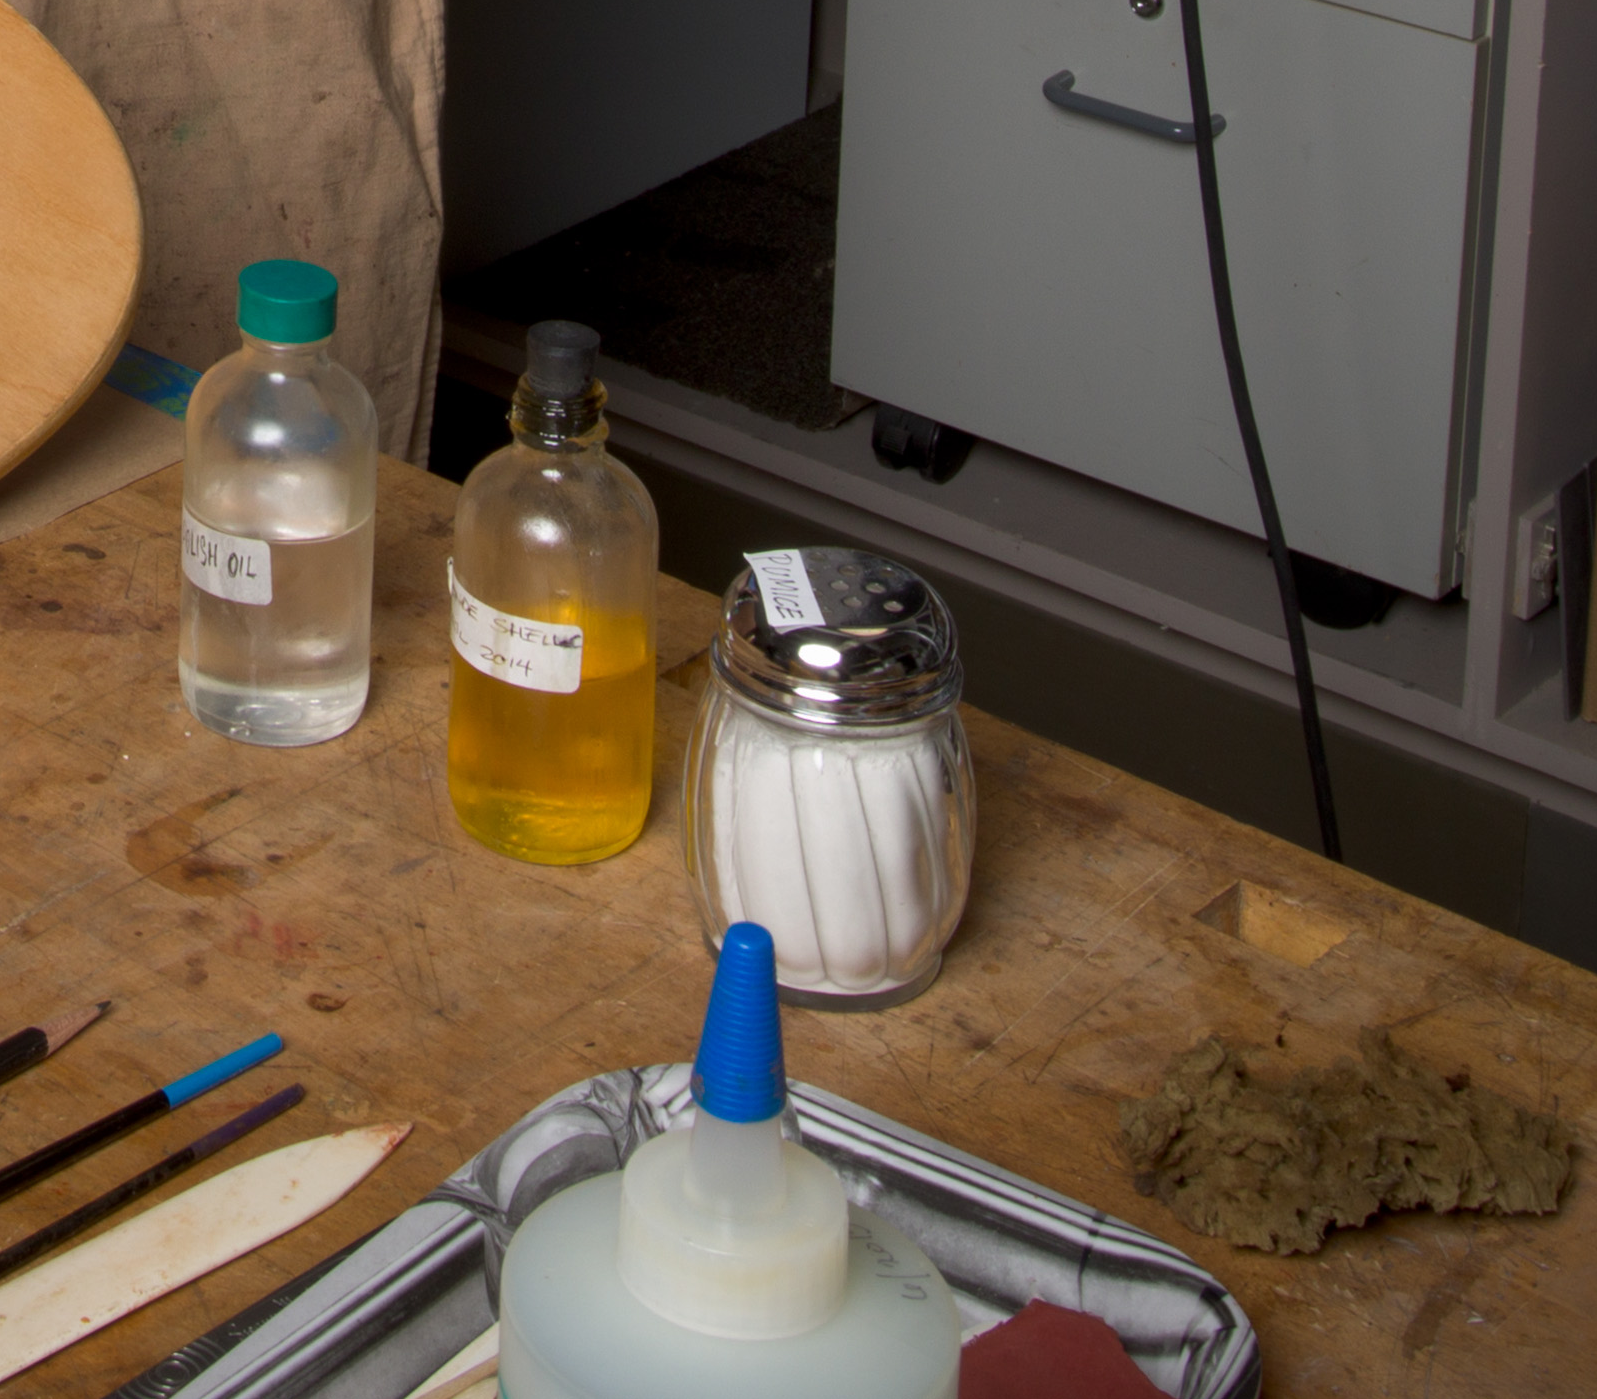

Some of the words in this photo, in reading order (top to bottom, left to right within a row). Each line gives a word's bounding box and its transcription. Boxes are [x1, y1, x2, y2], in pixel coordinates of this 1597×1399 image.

[185, 528, 218, 568] LISH
[227, 551, 257, 579] OIL
[751, 553, 805, 619] PUMICE
[479, 644, 533, 677] 2014
